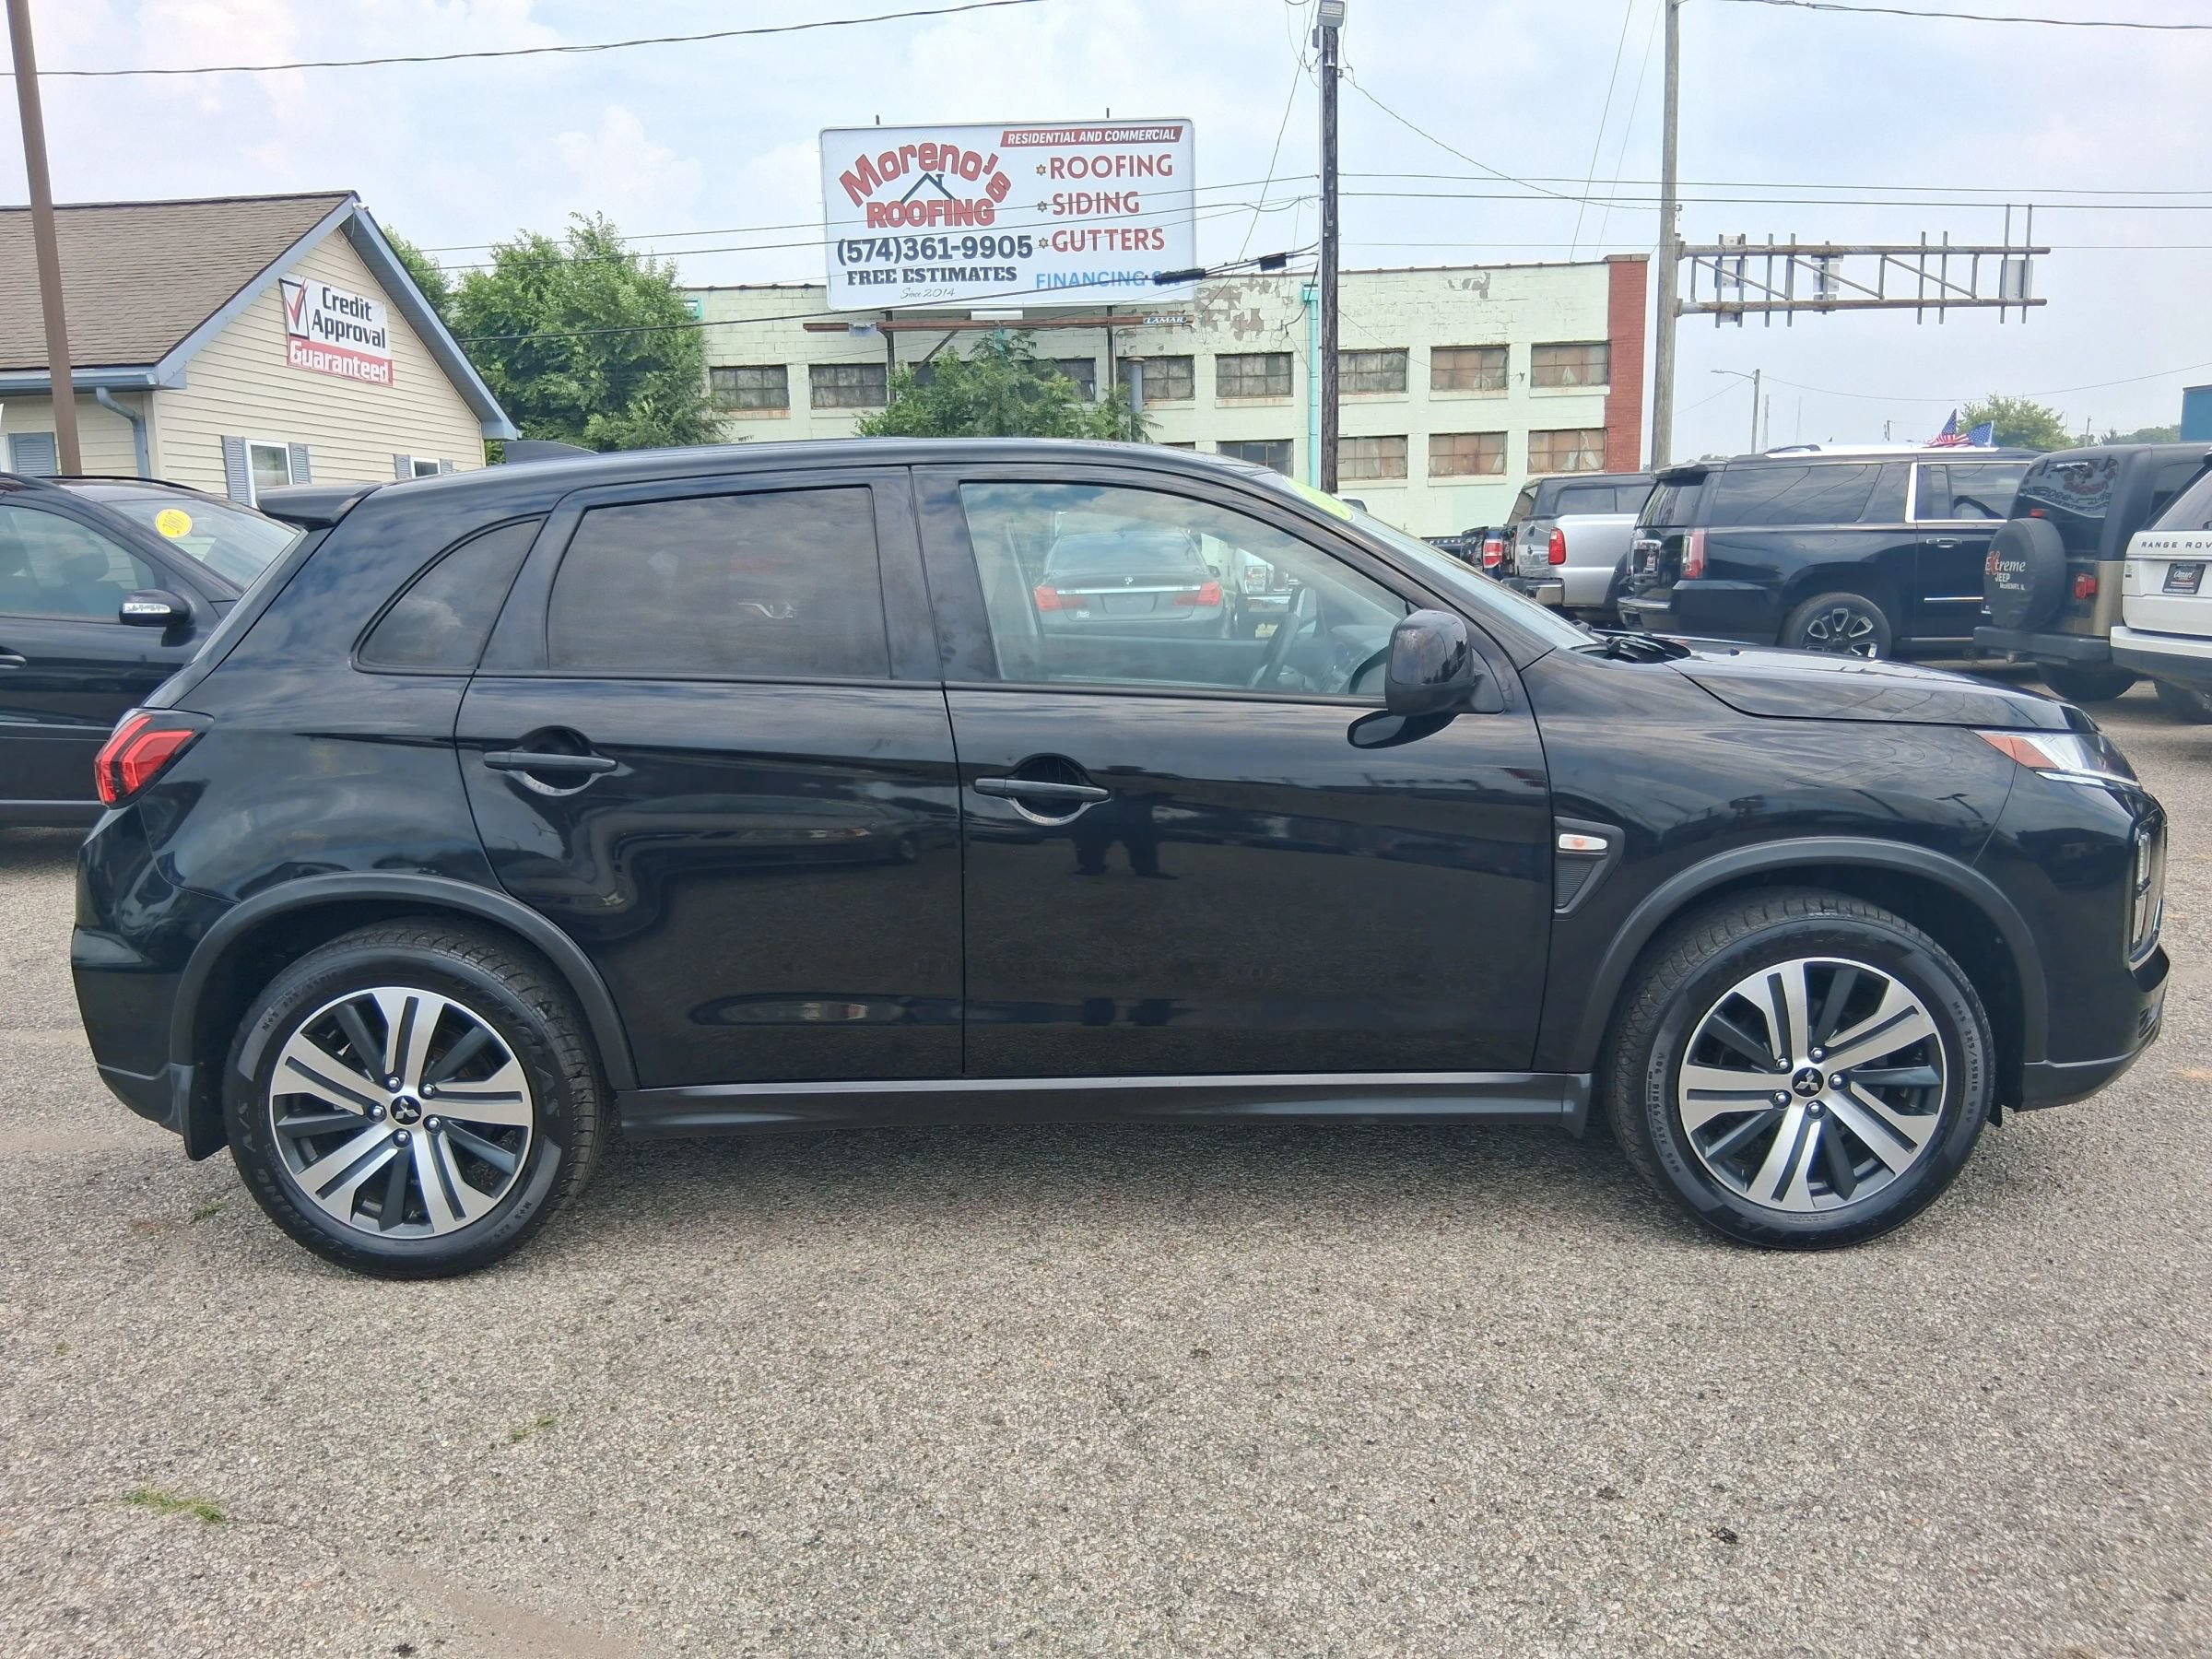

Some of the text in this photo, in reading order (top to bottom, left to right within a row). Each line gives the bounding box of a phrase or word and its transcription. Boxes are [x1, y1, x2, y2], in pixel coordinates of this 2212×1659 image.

[1007, 129, 1176, 145] RESIDENTIAL AND COMMERCIAL
[839, 142, 1011, 207] Moreno's
[1050, 154, 1173, 179] ROOFING
[866, 198, 995, 229] ROOFING
[1053, 191, 1139, 216] SIDING
[837, 235, 1033, 266] (574)361-9905
[1052, 228, 1165, 253] GUTTERS
[847, 266, 1018, 286] FREE ESTIMATES
[1036, 270, 1146, 288] FINANCING
[322, 287, 372, 322] Credit
[900, 288, 955, 300] Since 2014
[312, 309, 386, 349] Approval
[1147, 316, 1183, 324] LAMAR
[289, 340, 389, 383] Guaranteed
[1994, 572, 2011, 582] JEEP
